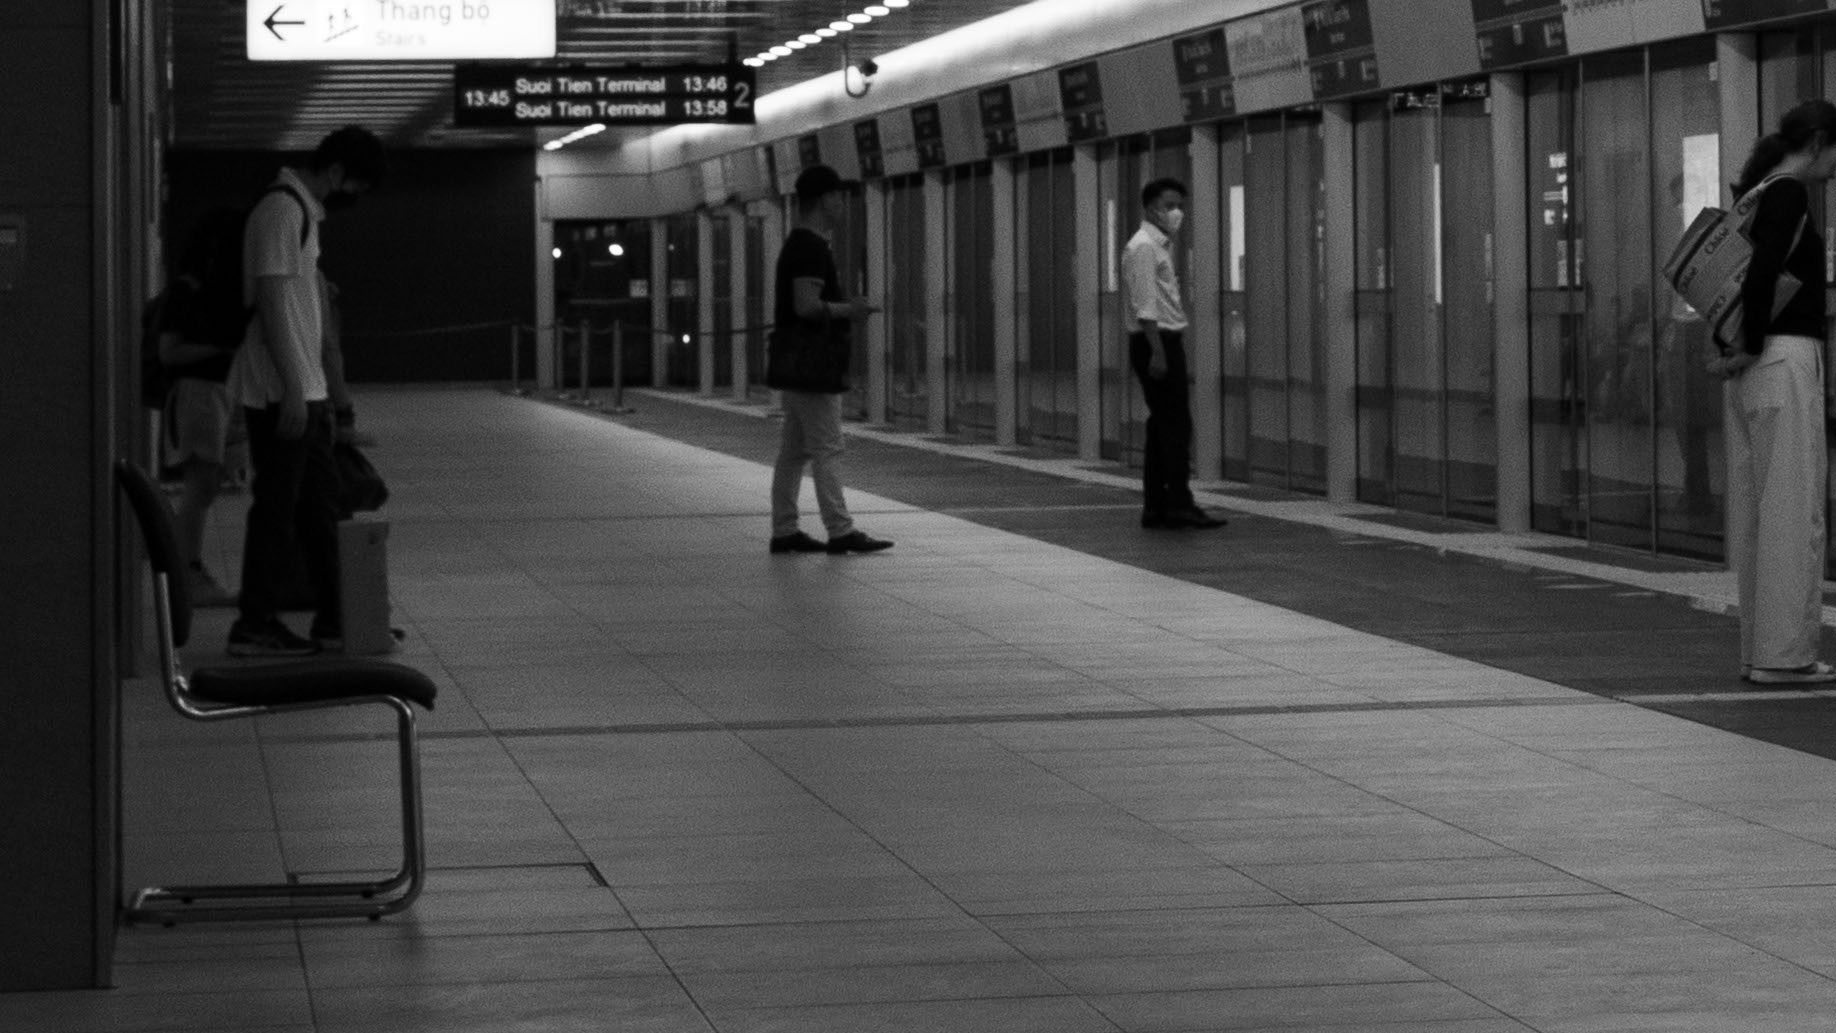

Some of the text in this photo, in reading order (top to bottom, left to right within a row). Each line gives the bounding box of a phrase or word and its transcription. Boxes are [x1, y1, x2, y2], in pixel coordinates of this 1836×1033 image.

[557, 76, 592, 94] Tien
[597, 76, 666, 93] Terminal
[683, 76, 727, 92] 13:46
[465, 89, 510, 107] 13:45
[734, 81, 749, 108] 2
[557, 100, 592, 118] Tien
[597, 100, 666, 117] Terminal
[683, 99, 727, 116] 13:58
